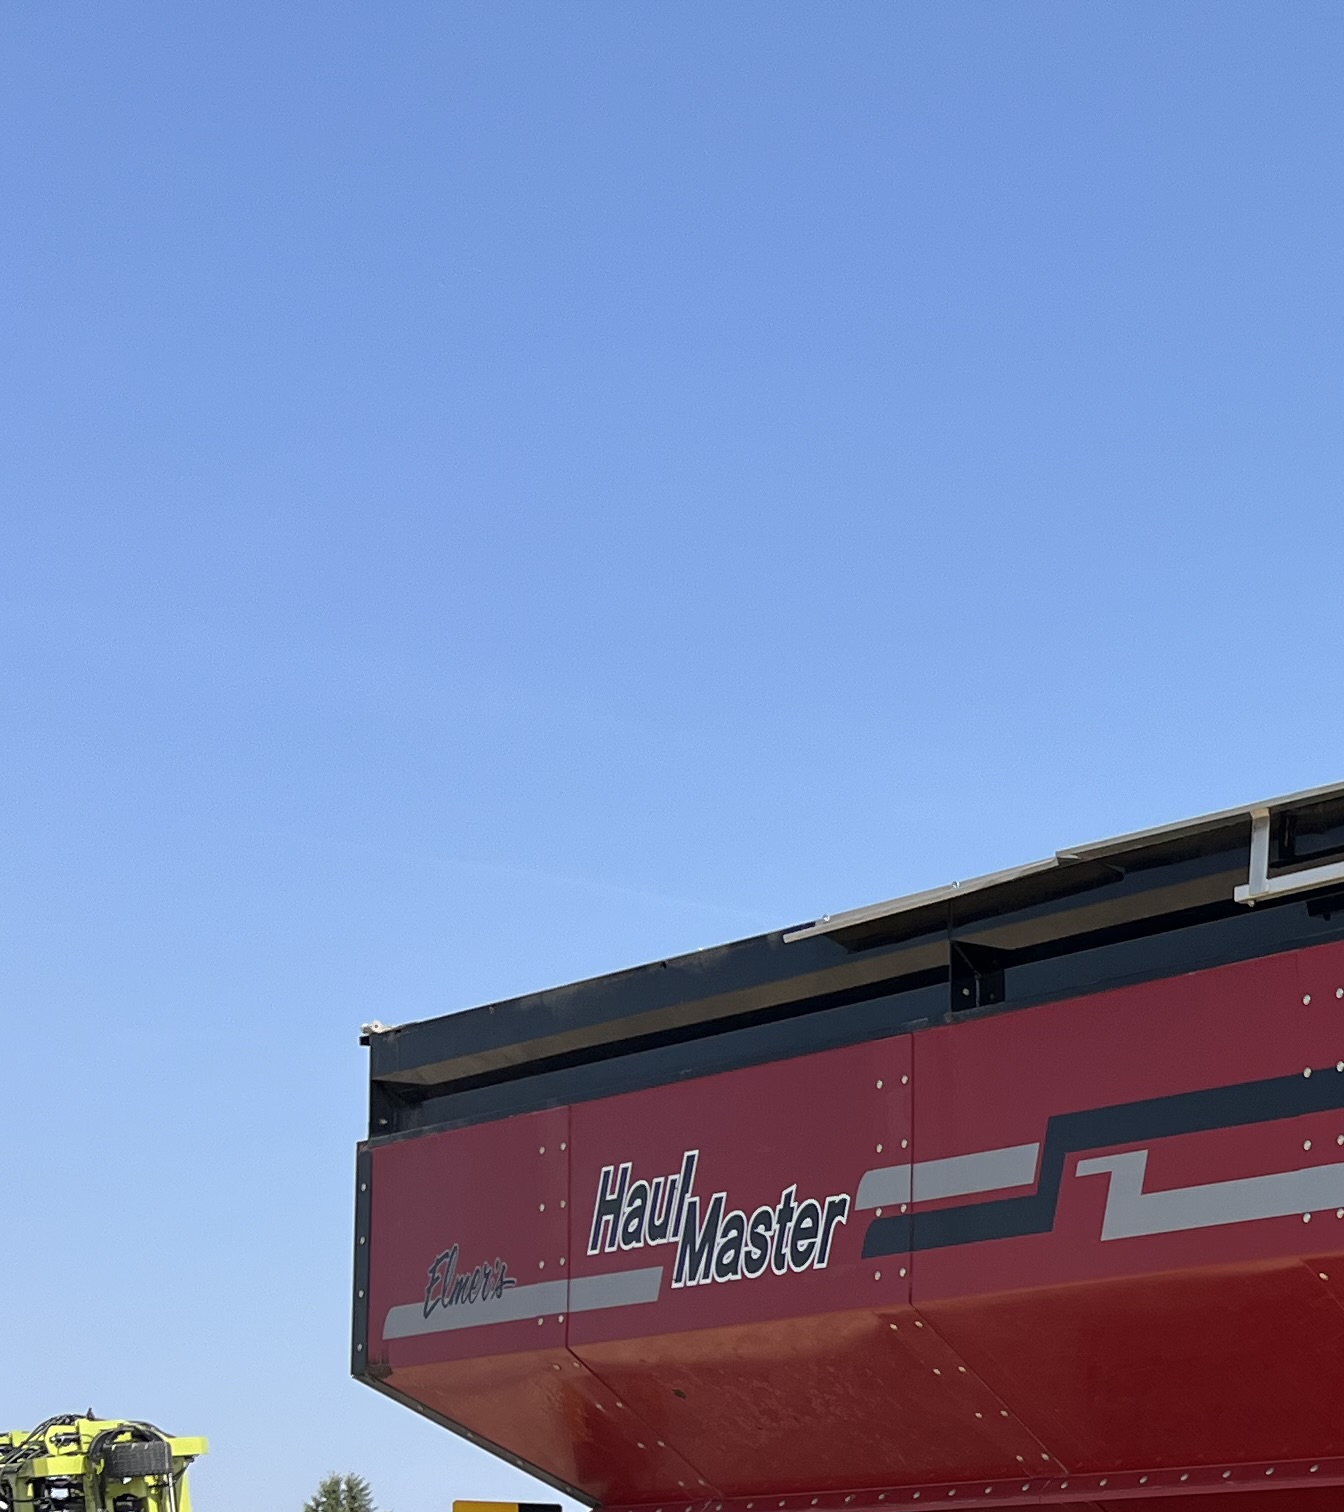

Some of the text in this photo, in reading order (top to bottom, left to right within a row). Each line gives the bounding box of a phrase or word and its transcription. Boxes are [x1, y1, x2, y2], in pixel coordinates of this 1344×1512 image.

[587, 1150, 699, 1256] Haul
[671, 1184, 850, 1288] Master
[423, 1243, 517, 1320] Elmer's
